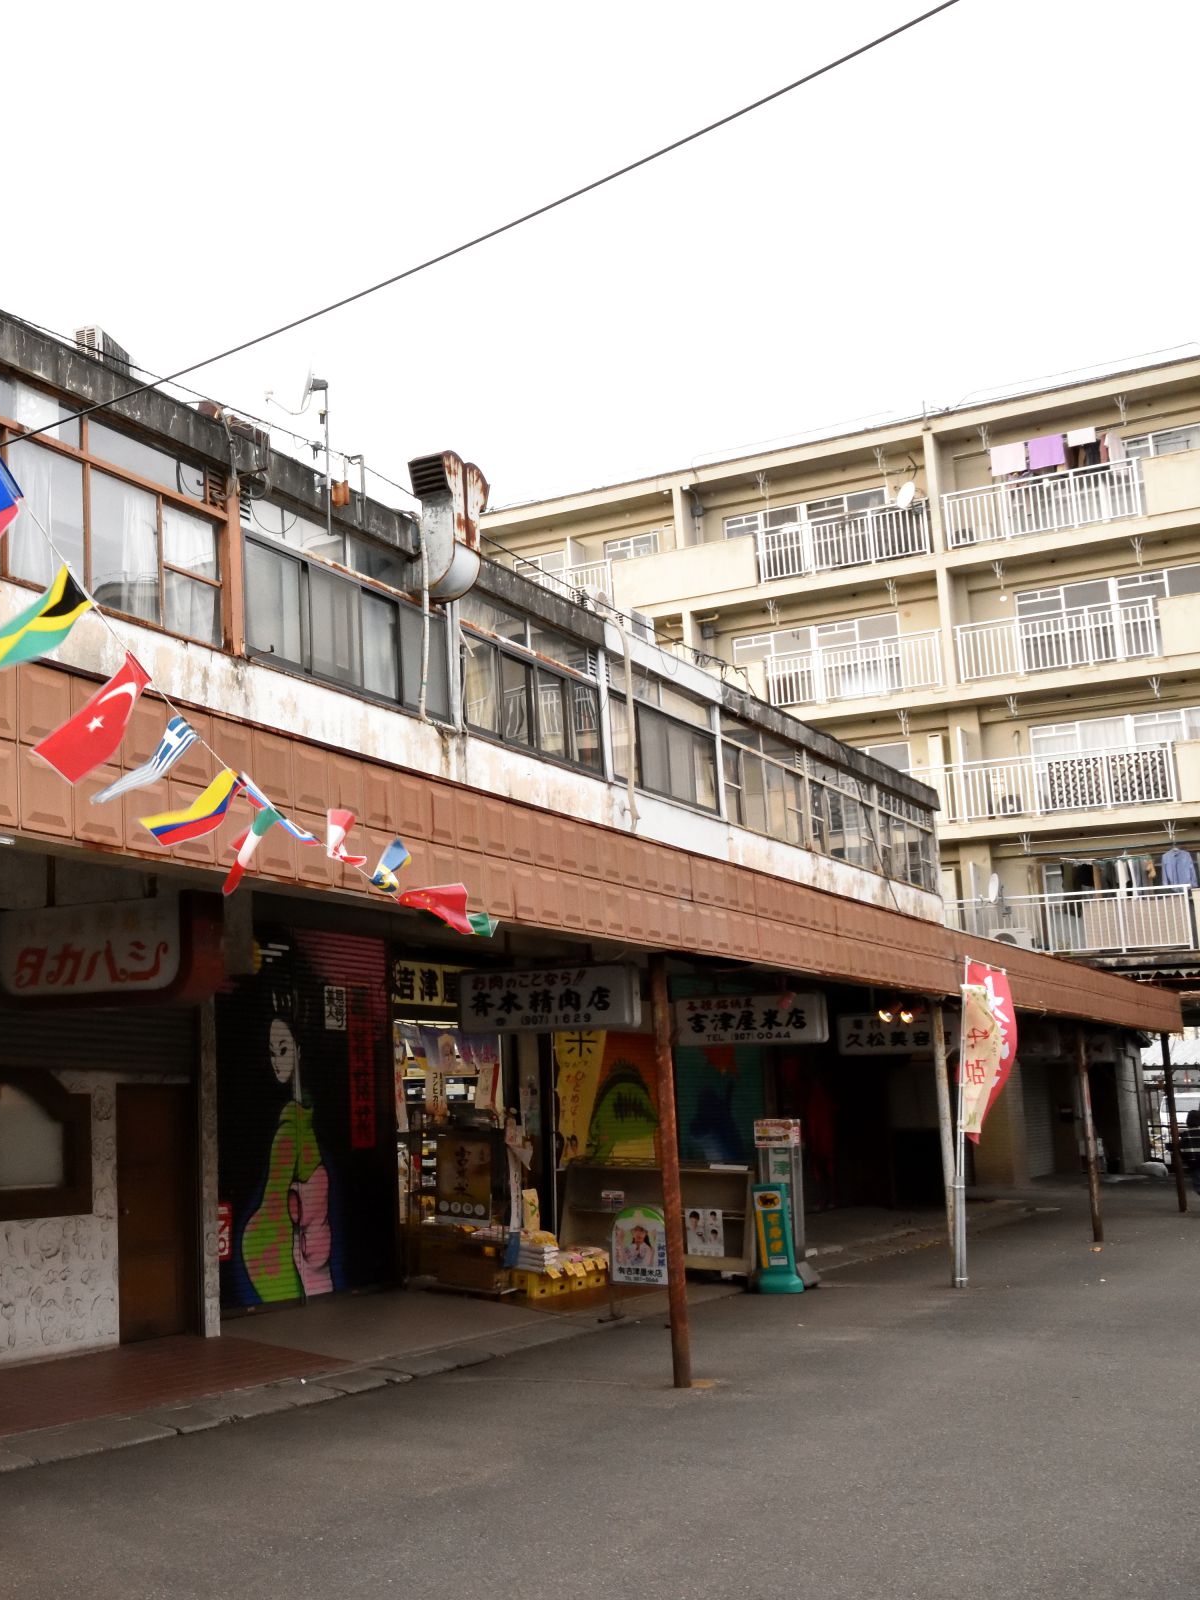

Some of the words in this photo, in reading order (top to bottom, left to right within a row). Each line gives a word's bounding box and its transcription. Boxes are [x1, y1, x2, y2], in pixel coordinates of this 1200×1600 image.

[15, 940, 168, 989] タカハシ
[687, 1009, 807, 1033] 吉津屋米店
